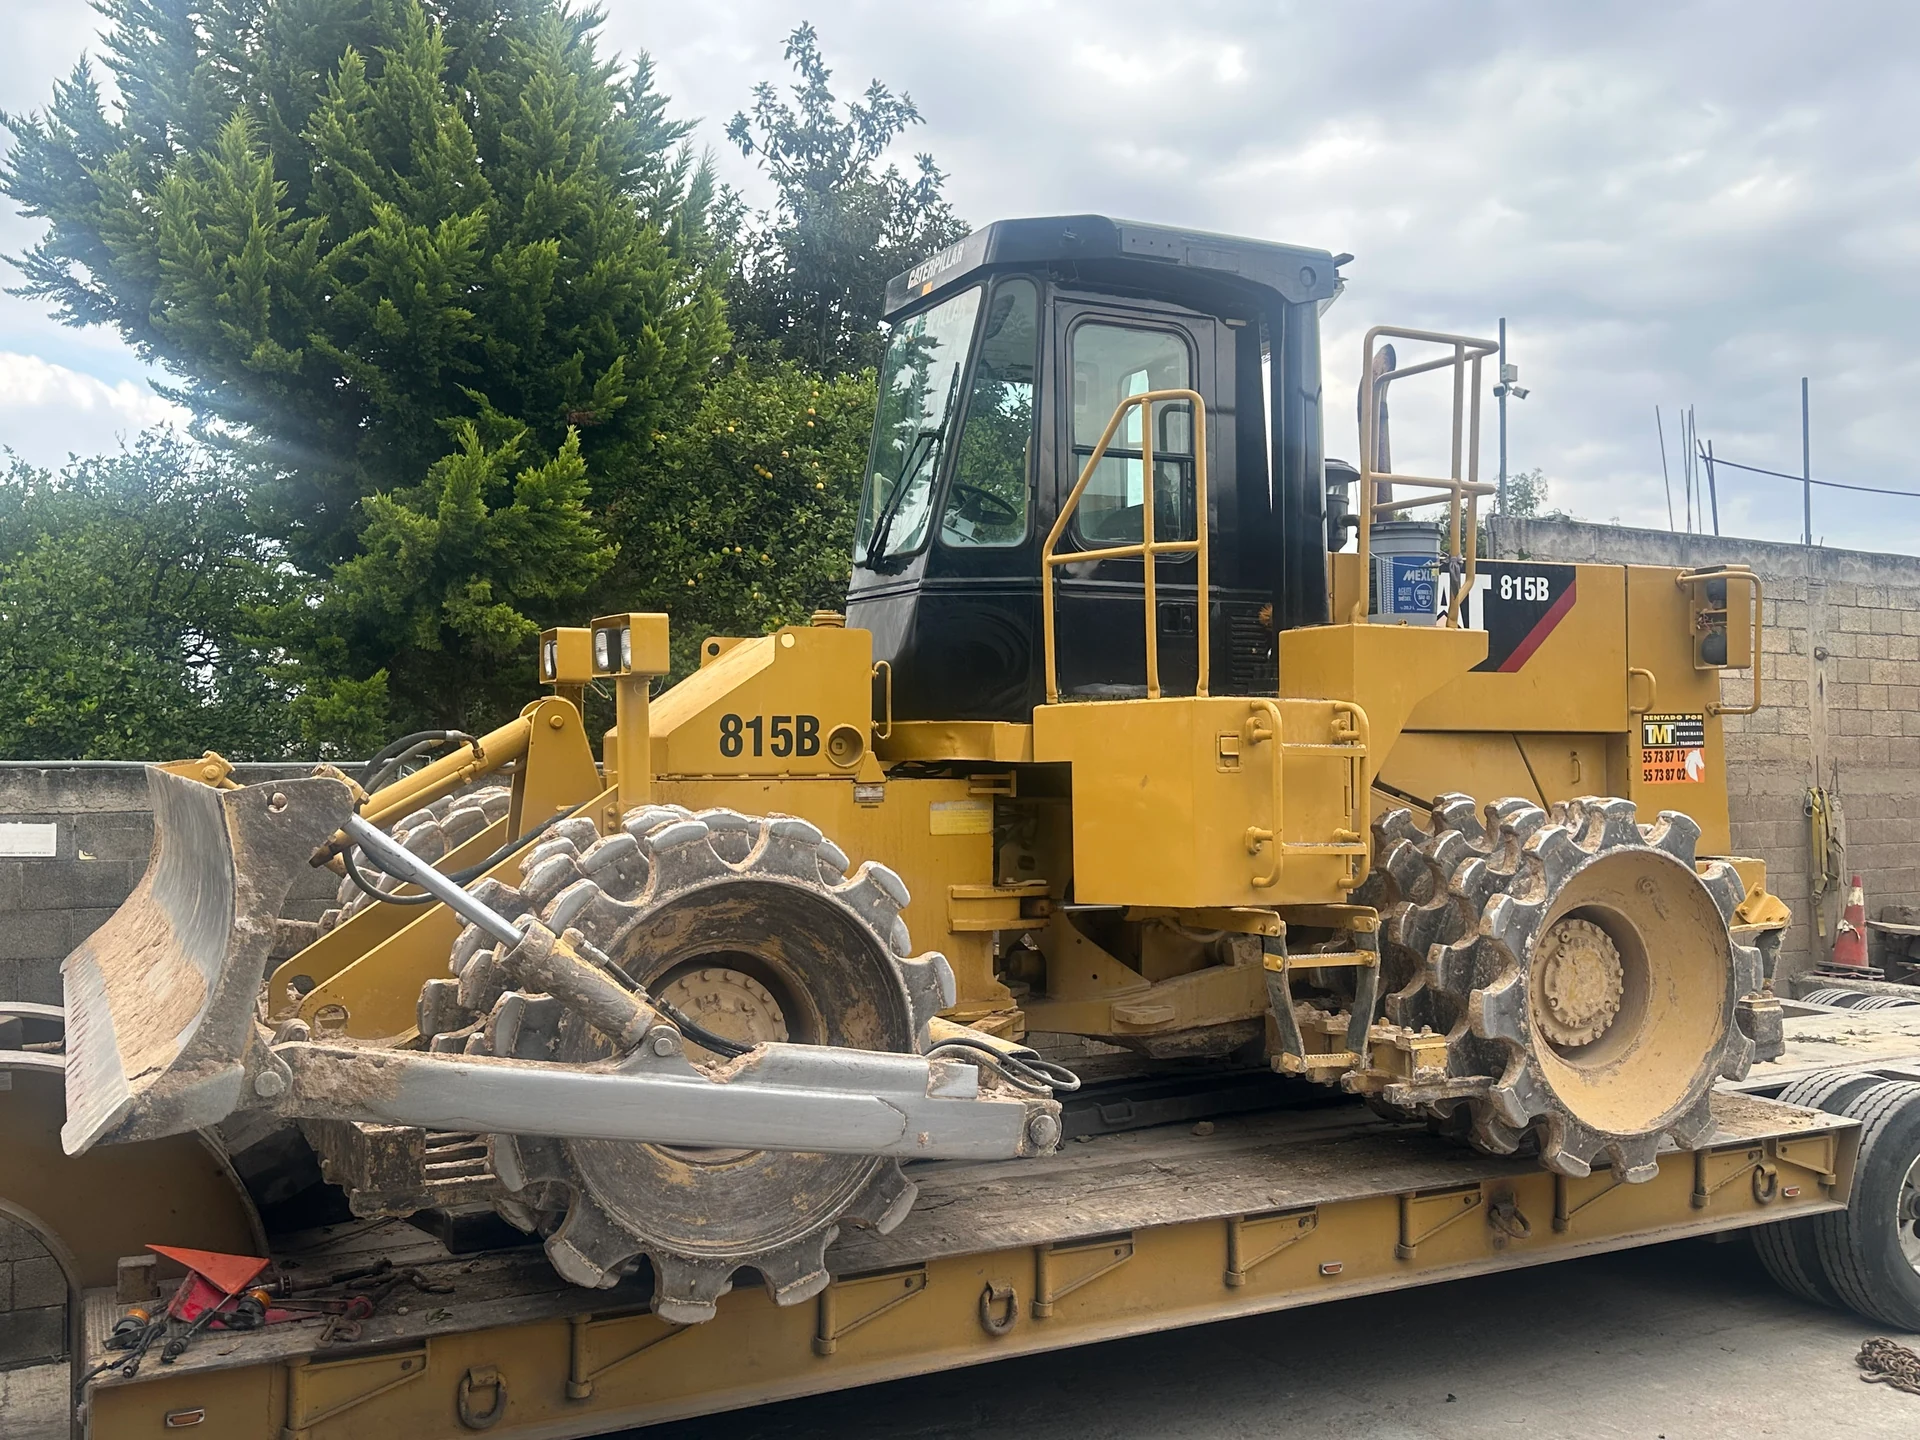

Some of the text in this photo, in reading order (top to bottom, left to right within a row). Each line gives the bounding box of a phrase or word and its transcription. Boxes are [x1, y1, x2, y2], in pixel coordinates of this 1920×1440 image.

[907, 243, 965, 290] CATERPILLAR
[1436, 572, 1492, 630] AT
[1500, 574, 1550, 601] 815B
[720, 713, 820, 757] 815B
[1645, 724, 1675, 744] TMT
[1643, 749, 1686, 763] 55 73 87 12
[1643, 768, 1686, 781] 55 73 87 02
